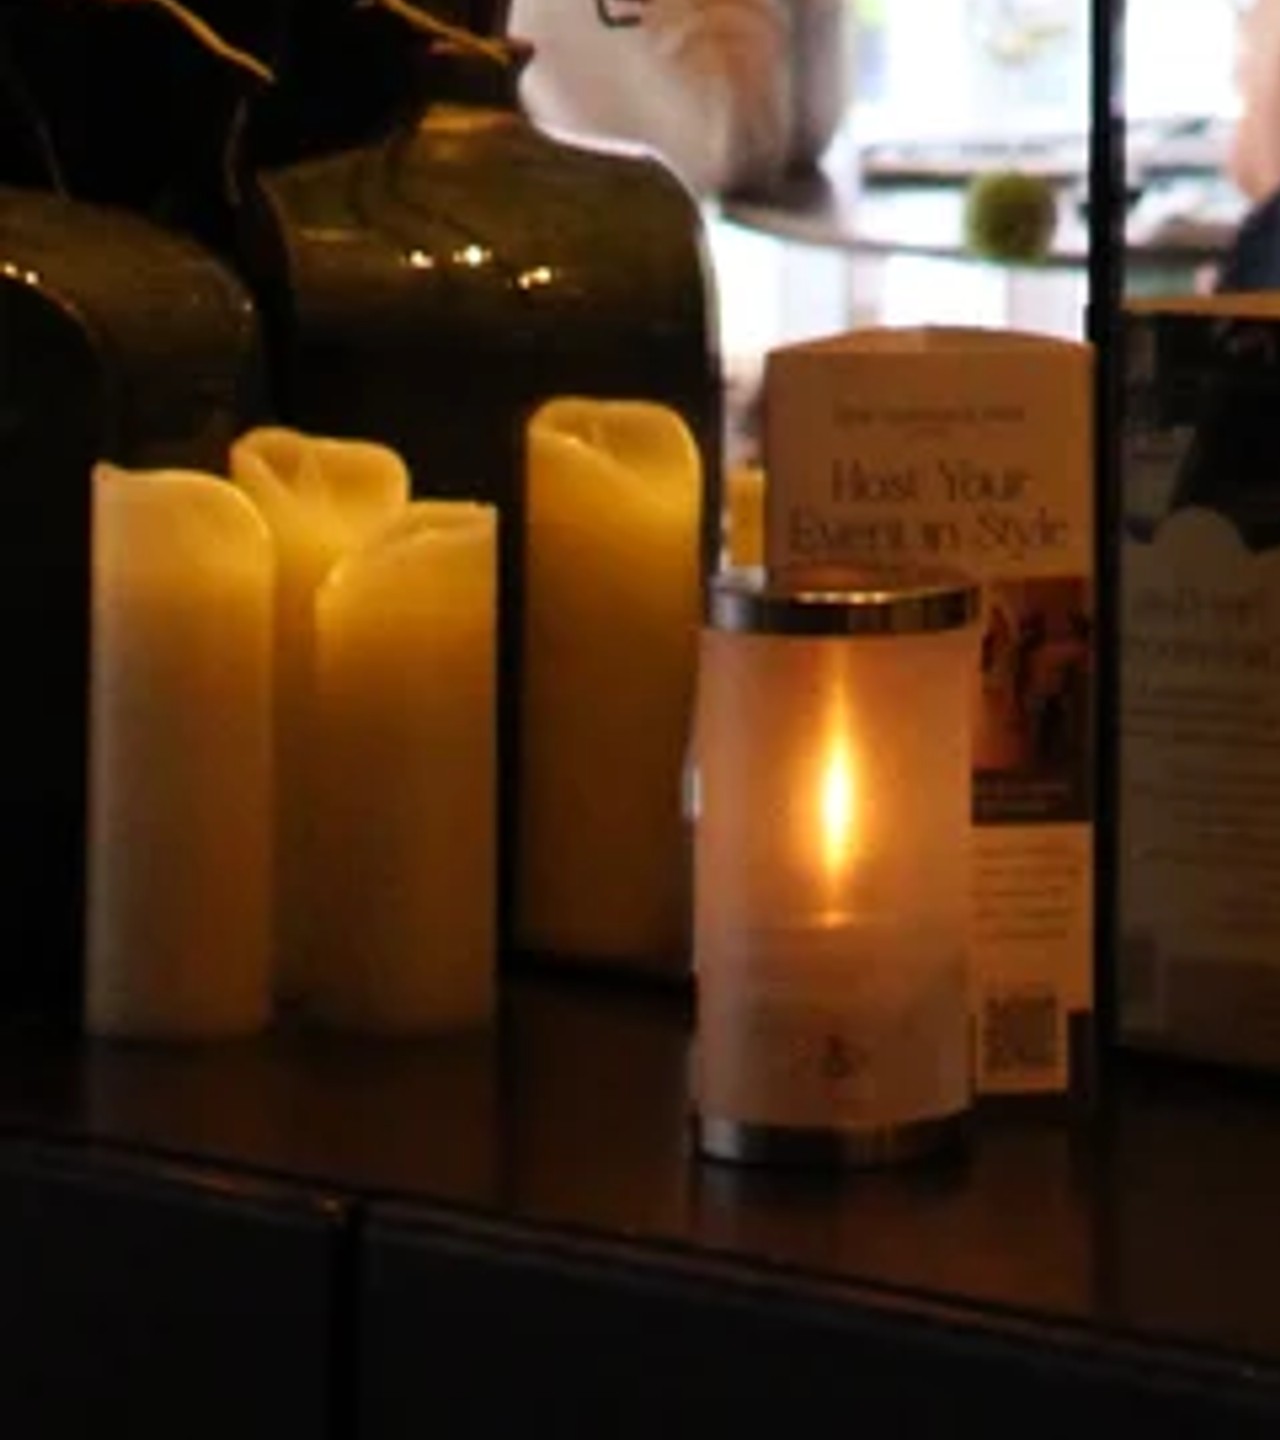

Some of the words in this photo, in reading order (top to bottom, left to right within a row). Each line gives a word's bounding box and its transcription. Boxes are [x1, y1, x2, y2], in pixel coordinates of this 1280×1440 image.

[831, 457, 918, 503] Host
[938, 458, 1034, 503] Your
[975, 506, 1070, 562] Style
